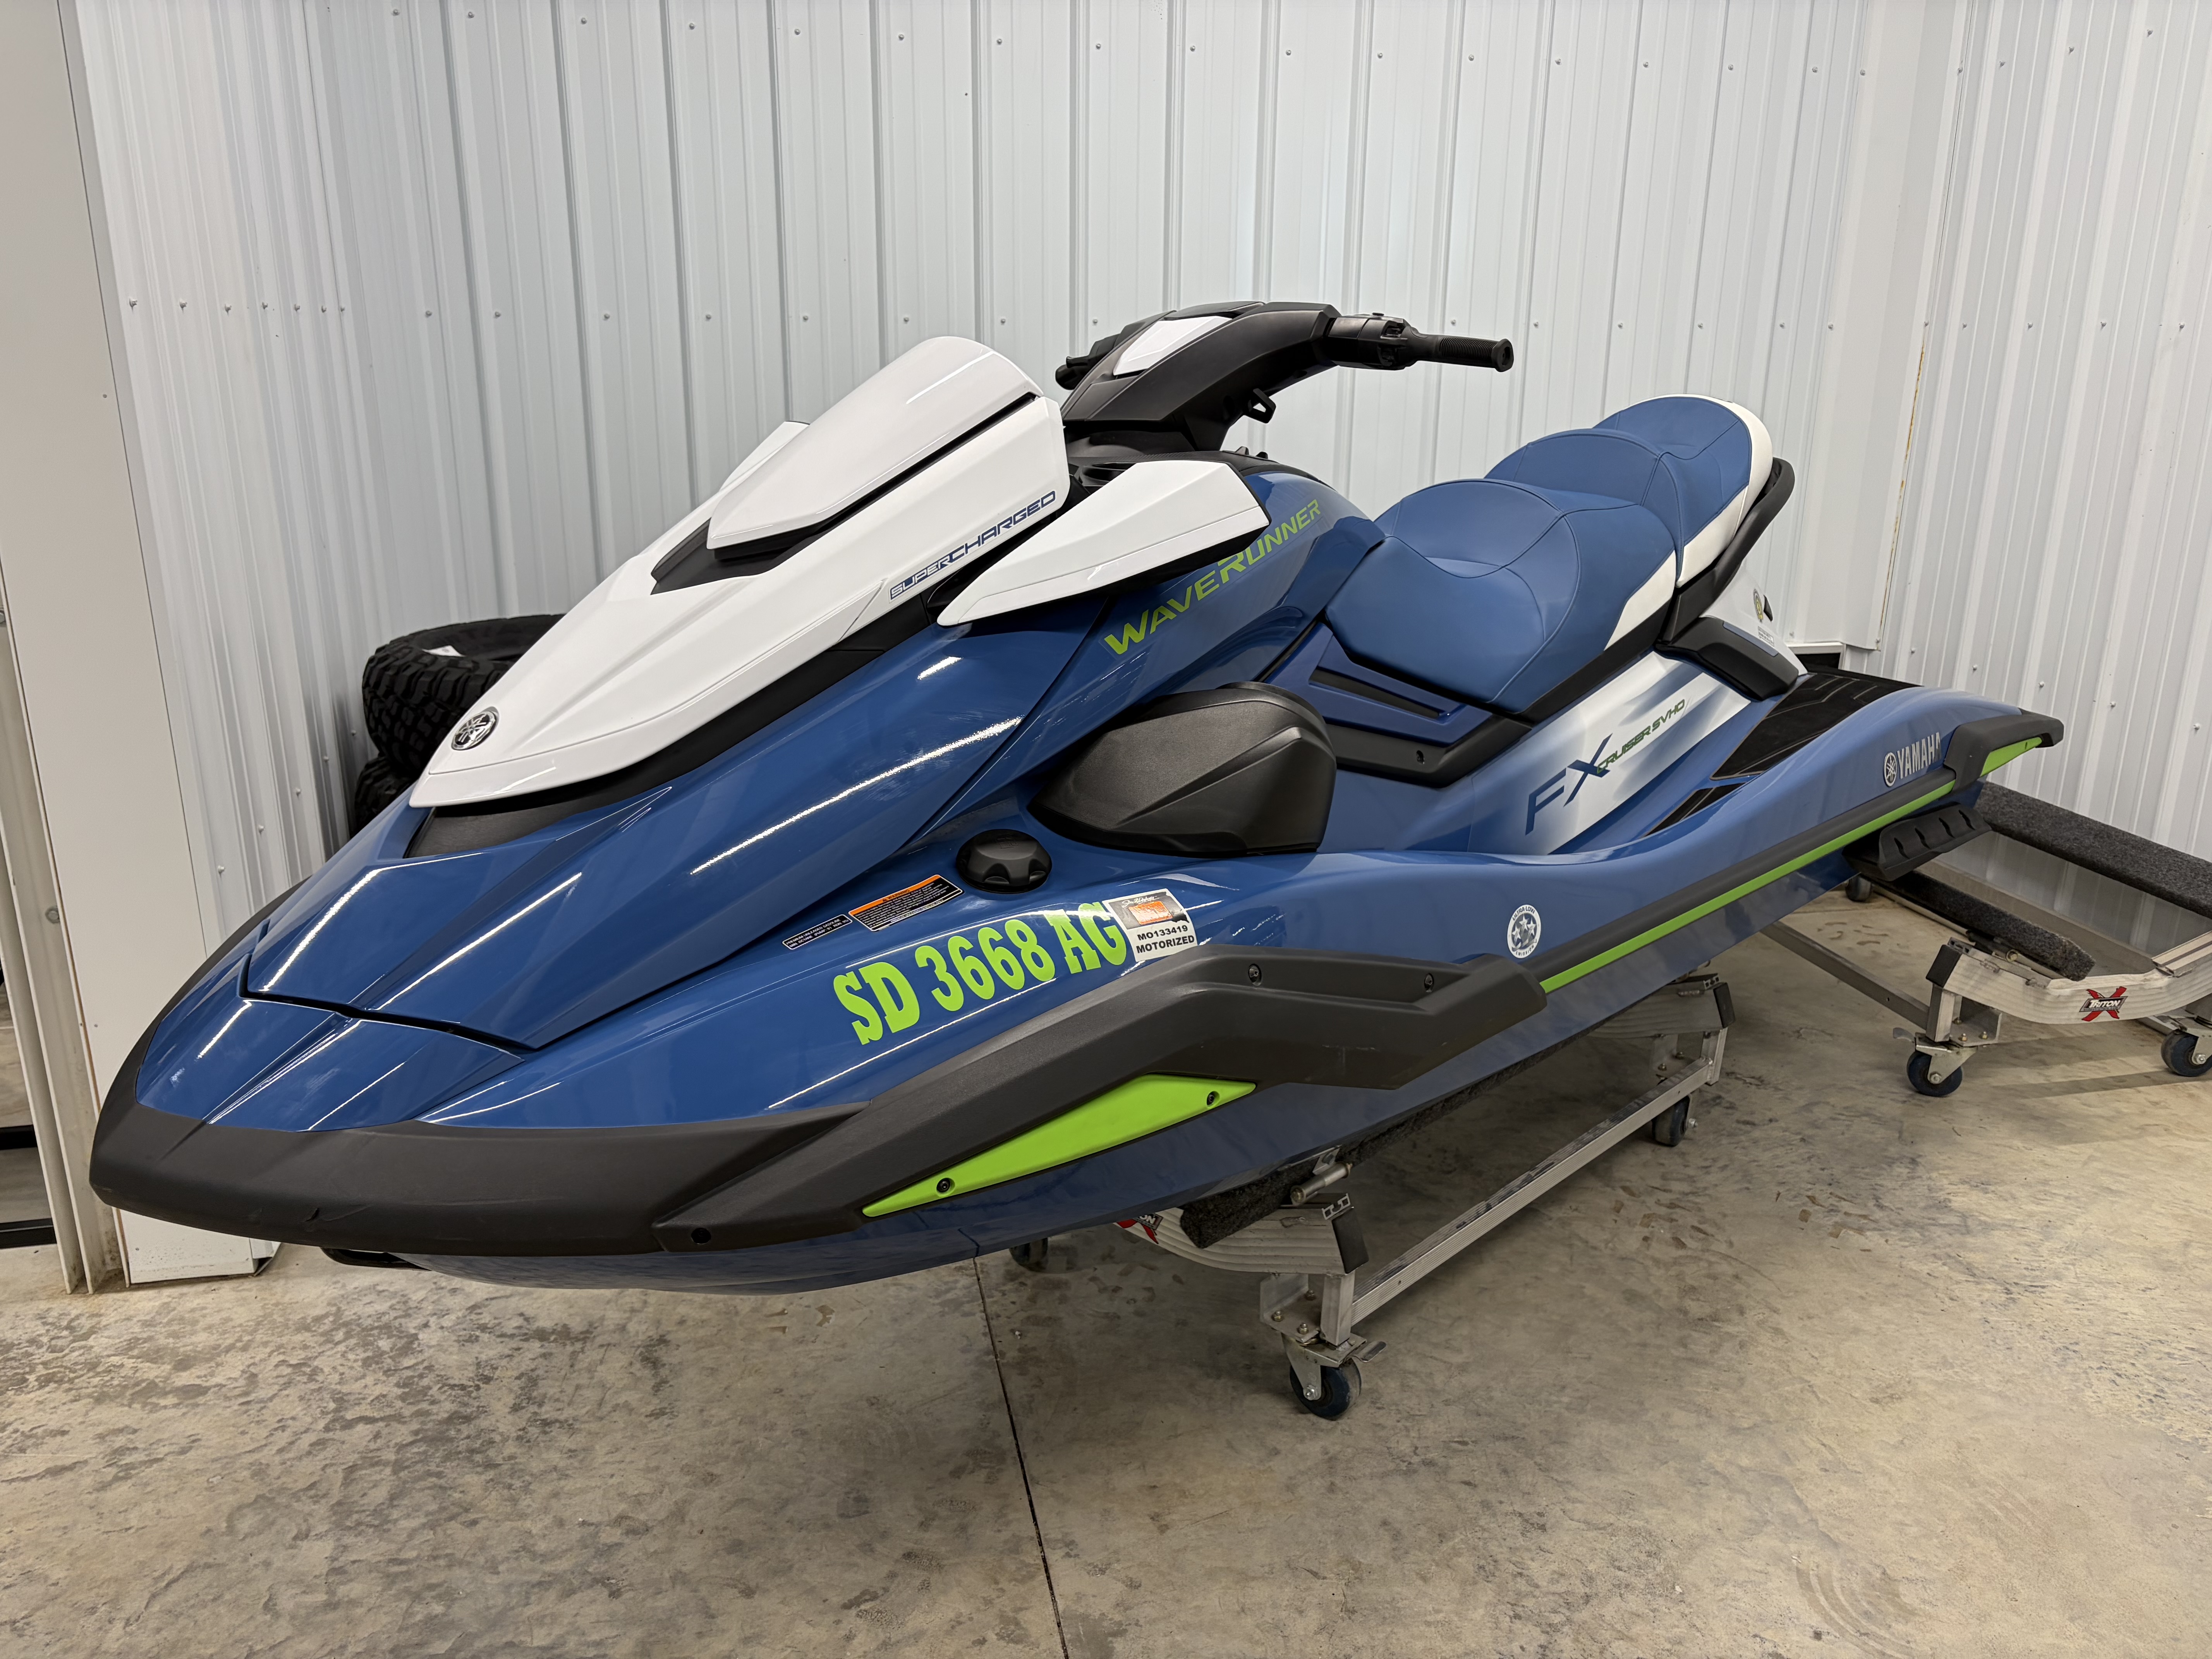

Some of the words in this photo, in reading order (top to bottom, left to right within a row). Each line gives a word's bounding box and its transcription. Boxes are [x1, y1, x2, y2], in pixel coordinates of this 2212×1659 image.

[890, 490, 1056, 601] SUPERCHARGED
[1104, 499, 1321, 655] WAVERUNNER
[1525, 732, 1613, 836] FX
[1597, 725, 1651, 774] CRUISER
[1652, 699, 1685, 732] SVHO
[1897, 731, 1942, 780] YAMAHA
[1137, 925, 1188, 941] MO133419
[1512, 907, 1525, 921] ULTRA
[1526, 906, 1535, 914] LOW
[1136, 935, 1195, 953] MOTORIZED
[833, 962, 920, 1045] SD
[915, 919, 1056, 1012] 3668
[1044, 902, 1127, 974] AG
[2089, 1000, 2121, 1008] TRITON
